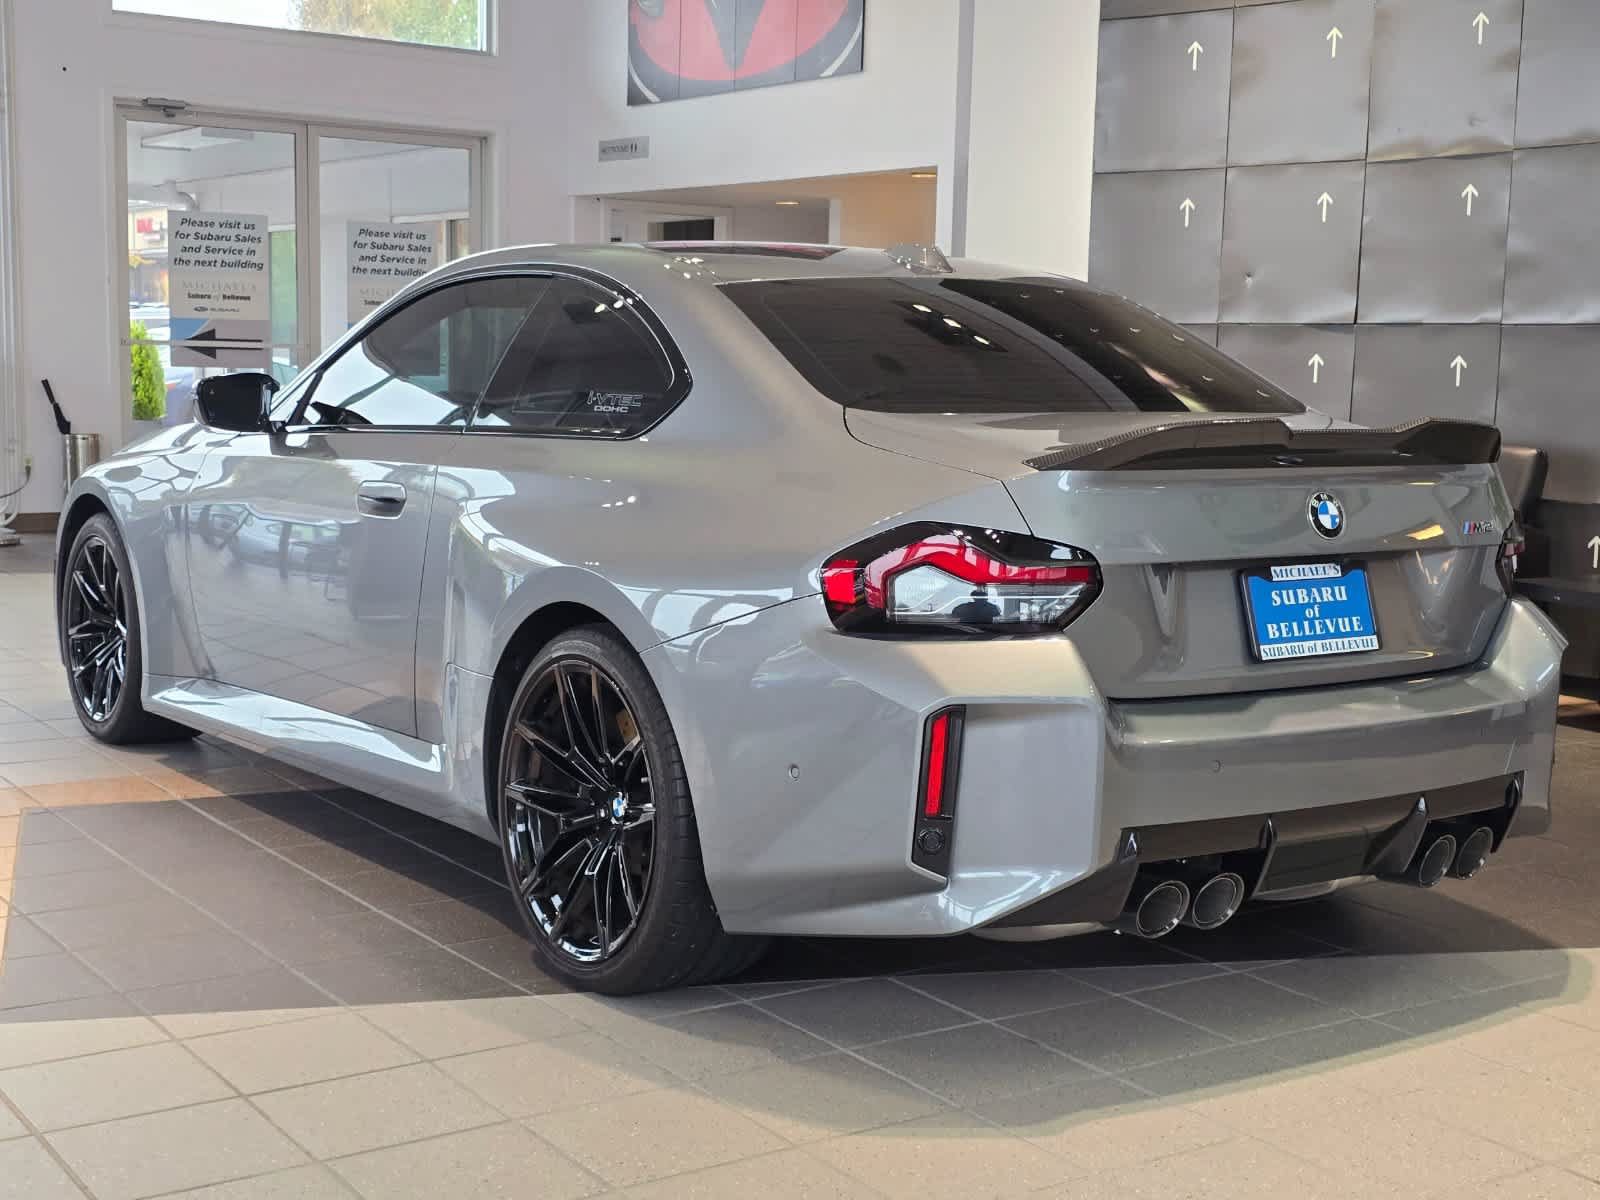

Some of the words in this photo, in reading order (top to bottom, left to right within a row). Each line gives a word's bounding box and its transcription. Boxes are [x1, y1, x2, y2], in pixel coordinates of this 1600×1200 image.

[180, 217, 215, 228] Please
[219, 219, 241, 229] visit
[244, 222, 256, 230] us
[174, 230, 191, 240] for
[193, 231, 231, 242] Subaru
[234, 234, 262, 244] Sales
[358, 228, 391, 238] Please
[393, 230, 414, 240] visit
[416, 233, 427, 241] us
[180, 245, 202, 254] and
[204, 246, 244, 256] Service
[246, 248, 256, 257] in
[353, 240, 369, 249] for
[370, 241, 405, 252] Subaru
[407, 243, 432, 253] Sales
[173, 257, 191, 267] the
[194, 258, 218, 268] next
[220, 260, 264, 272] building
[358, 254, 378, 263] and
[379, 254, 415, 264] Service
[418, 256, 427, 265] in
[352, 266, 368, 275] the
[370, 267, 392, 276] next
[394, 267, 427, 277] buildin
[593, 405, 629, 413] DOHC
[1272, 564, 1340, 579] MICHAEL'S
[1271, 585, 1348, 606] SUBARU
[1305, 604, 1320, 618] of
[1266, 616, 1363, 639] BELLEVUE
[1262, 644, 1305, 658] SUBARU
[1307, 643, 1318, 655] of
[1321, 637, 1377, 651] BELLEVUE
